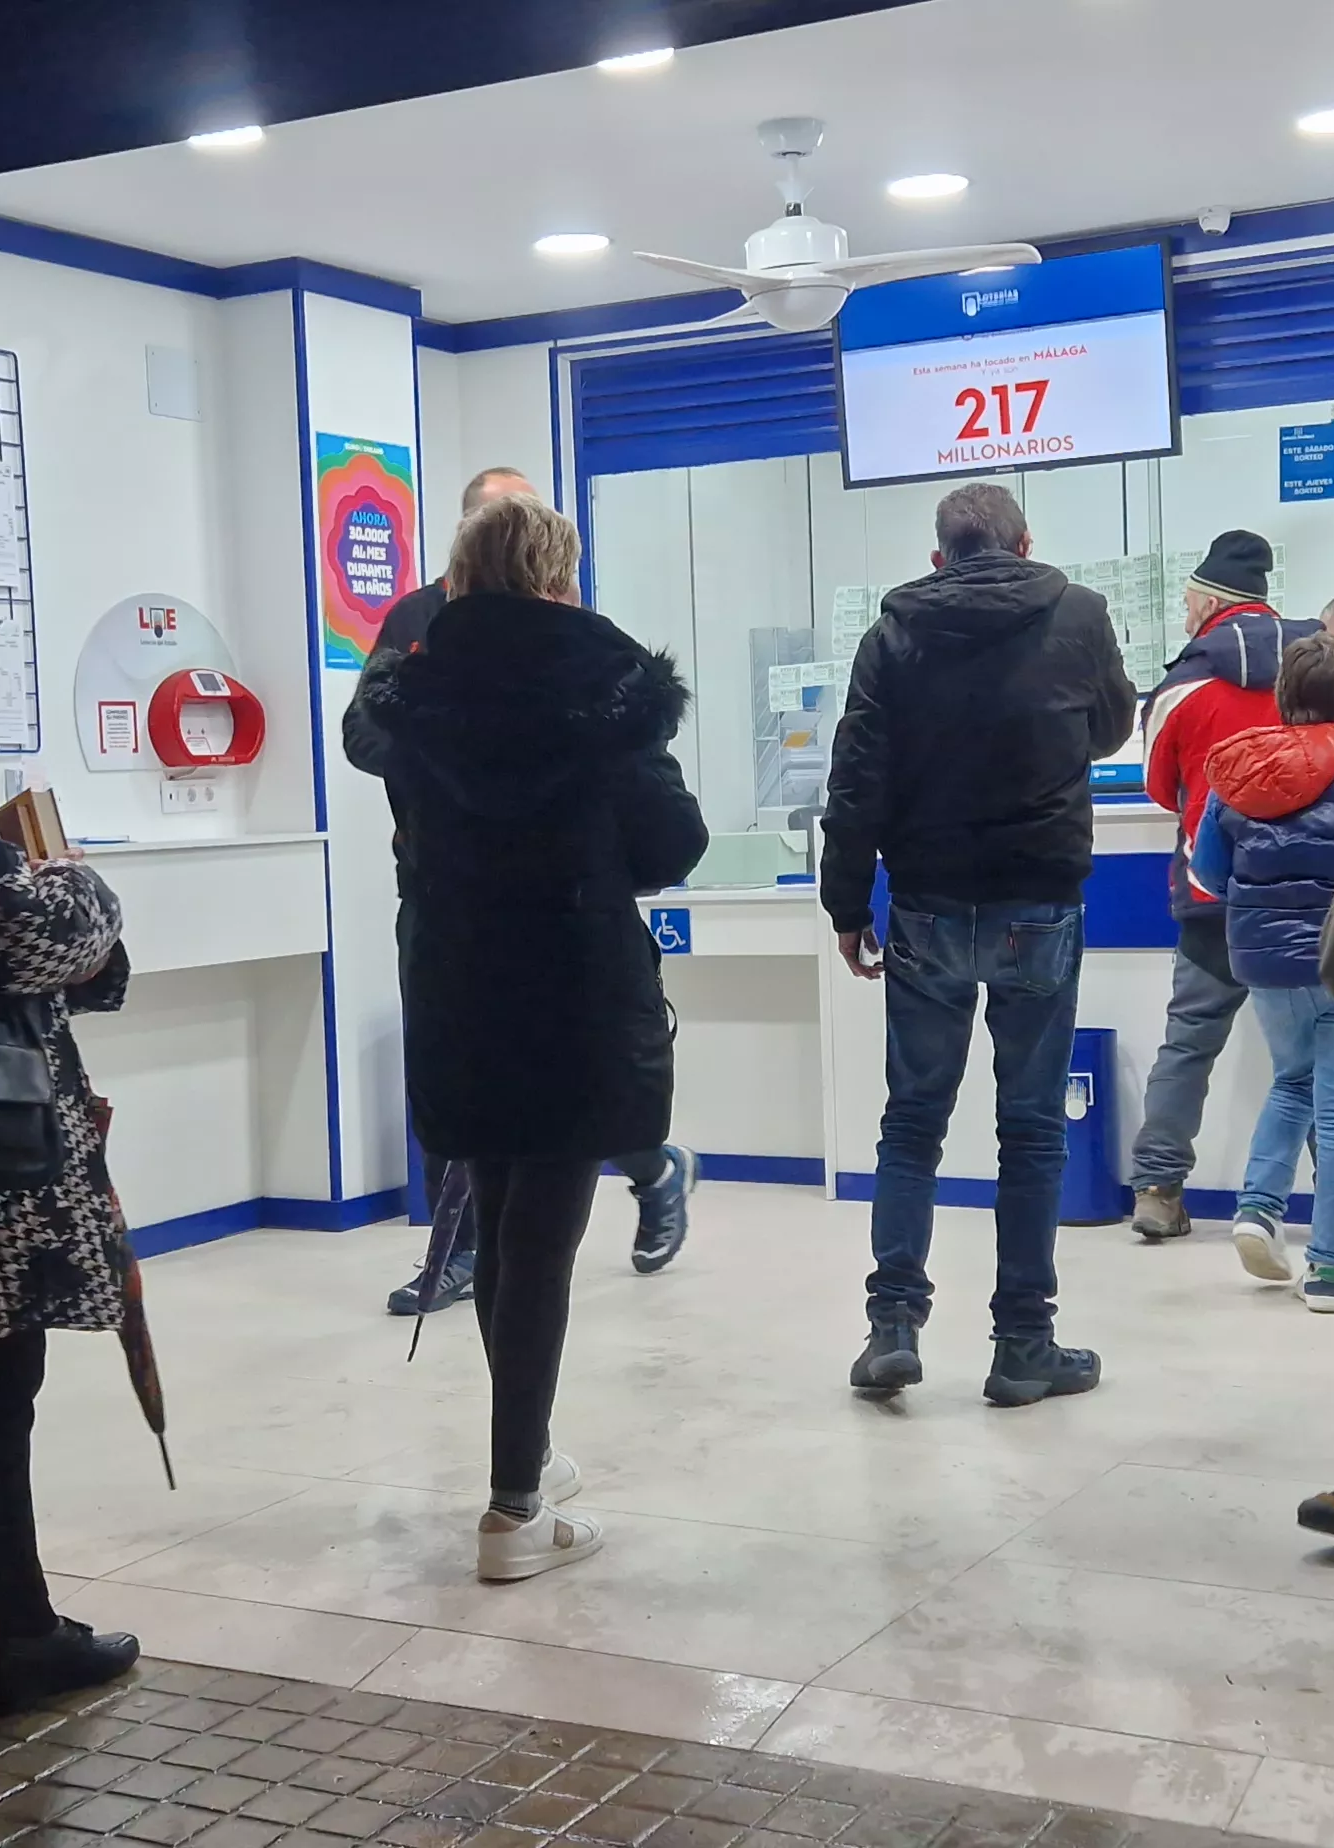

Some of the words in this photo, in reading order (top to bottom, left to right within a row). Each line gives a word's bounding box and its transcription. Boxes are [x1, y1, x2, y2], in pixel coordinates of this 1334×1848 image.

[913, 367, 932, 376] Esta
[934, 363, 968, 373] semana
[970, 359, 982, 369] ha
[984, 356, 1016, 367] tocado
[1018, 354, 1031, 362] en
[1033, 344, 1088, 361] MÁLAGA
[954, 379, 1052, 441] 217
[937, 434, 1074, 465] MILLONARIOS
[1283, 447, 1302, 455] ESTE
[1284, 480, 1303, 488] ESTE
[1305, 478, 1333, 487] JUEVES
[352, 511, 388, 527] AHORA
[353, 545, 366, 559] AL
[367, 546, 386, 560] MES
[347, 562, 393, 579] DURANTE
[353, 580, 366, 594] 30
[366, 578, 392, 596] AÑOS
